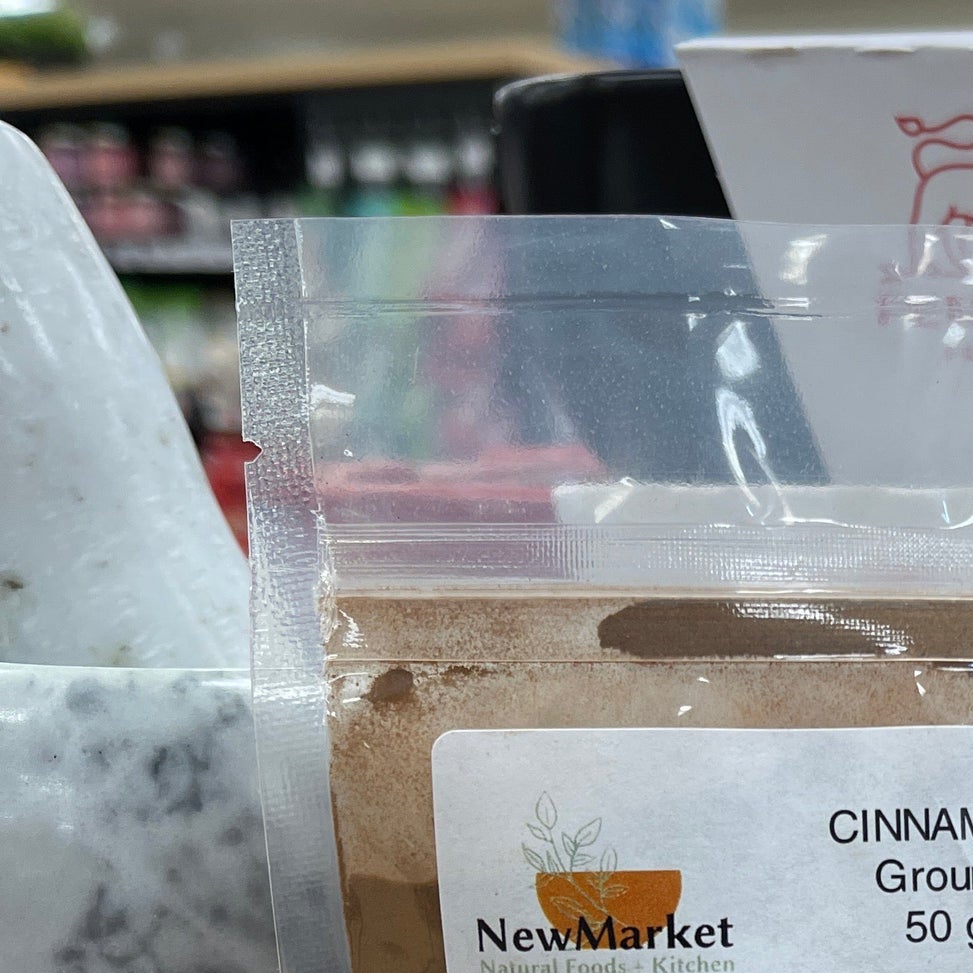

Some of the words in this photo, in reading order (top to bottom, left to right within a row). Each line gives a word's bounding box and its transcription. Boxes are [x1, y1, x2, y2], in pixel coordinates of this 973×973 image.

[476, 913, 735, 953] NewMarket
[905, 909, 952, 943] 50
[652, 955, 736, 973] Kitchen
